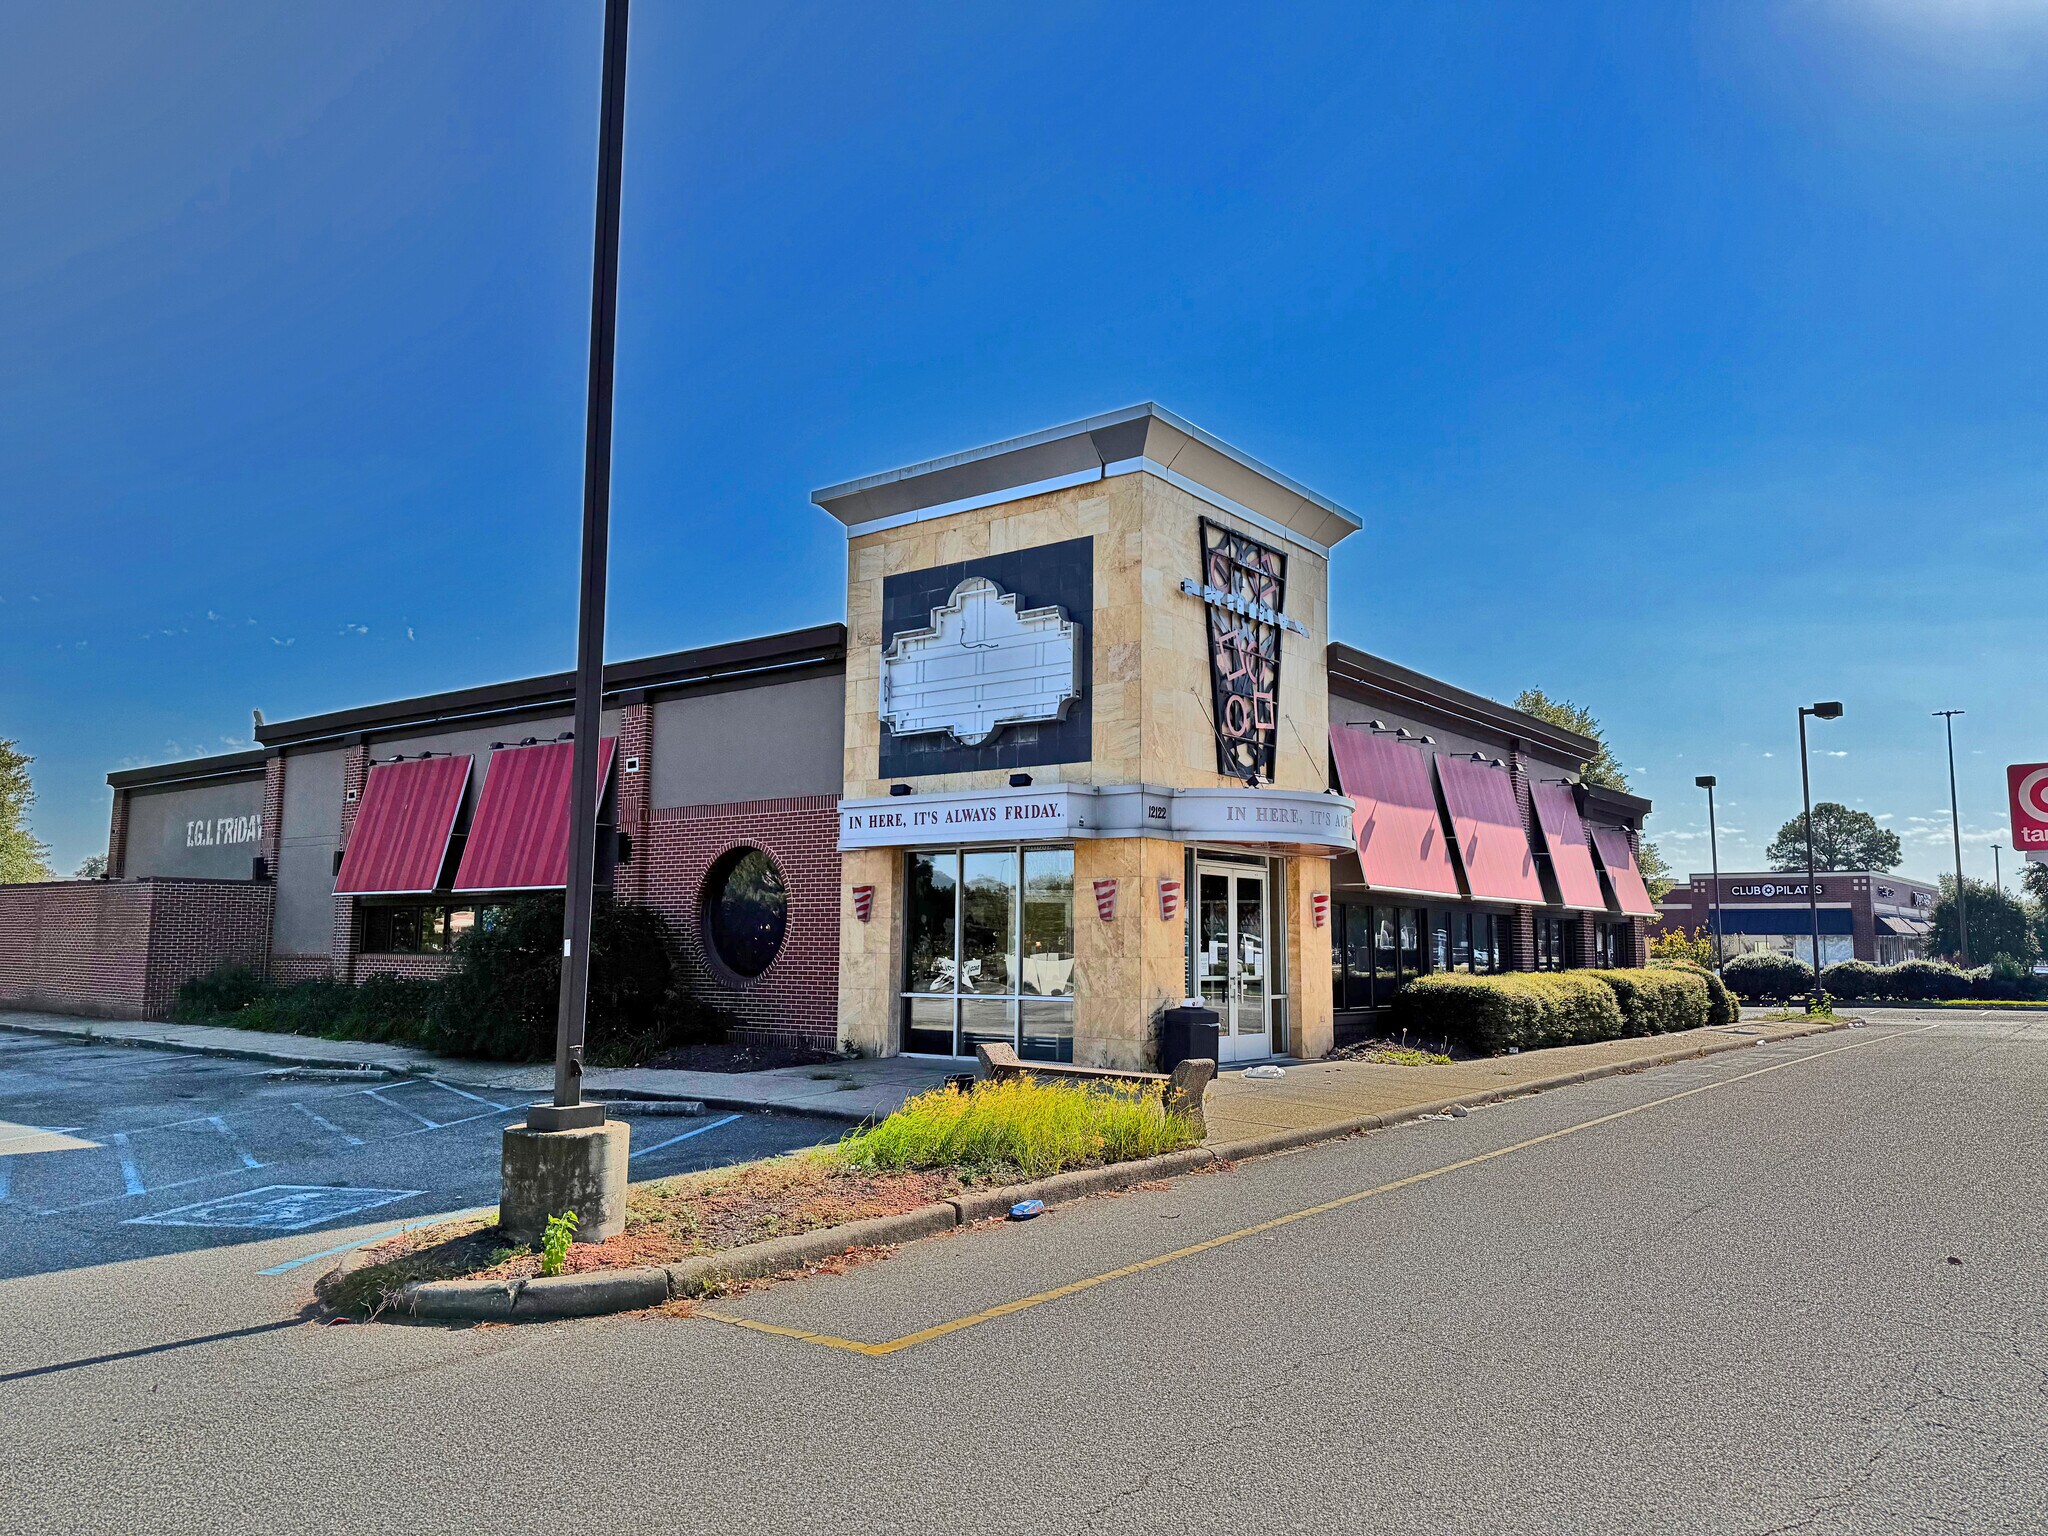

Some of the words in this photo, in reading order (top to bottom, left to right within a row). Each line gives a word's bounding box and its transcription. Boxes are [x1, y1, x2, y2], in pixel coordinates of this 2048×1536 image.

[849, 815, 863, 830] IN
[869, 813, 907, 828] HERE,
[914, 810, 938, 826] IT'S
[945, 806, 997, 824] ALWAYS
[1005, 802, 1062, 820] FRIDAY.
[1148, 805, 1167, 820] 12122
[1226, 806, 1247, 821] IN
[1256, 807, 1303, 825] HERE,
[1310, 810, 1331, 827] IT'S
[1731, 886, 1761, 896] CLUB
[1776, 885, 1823, 895] PILATS
